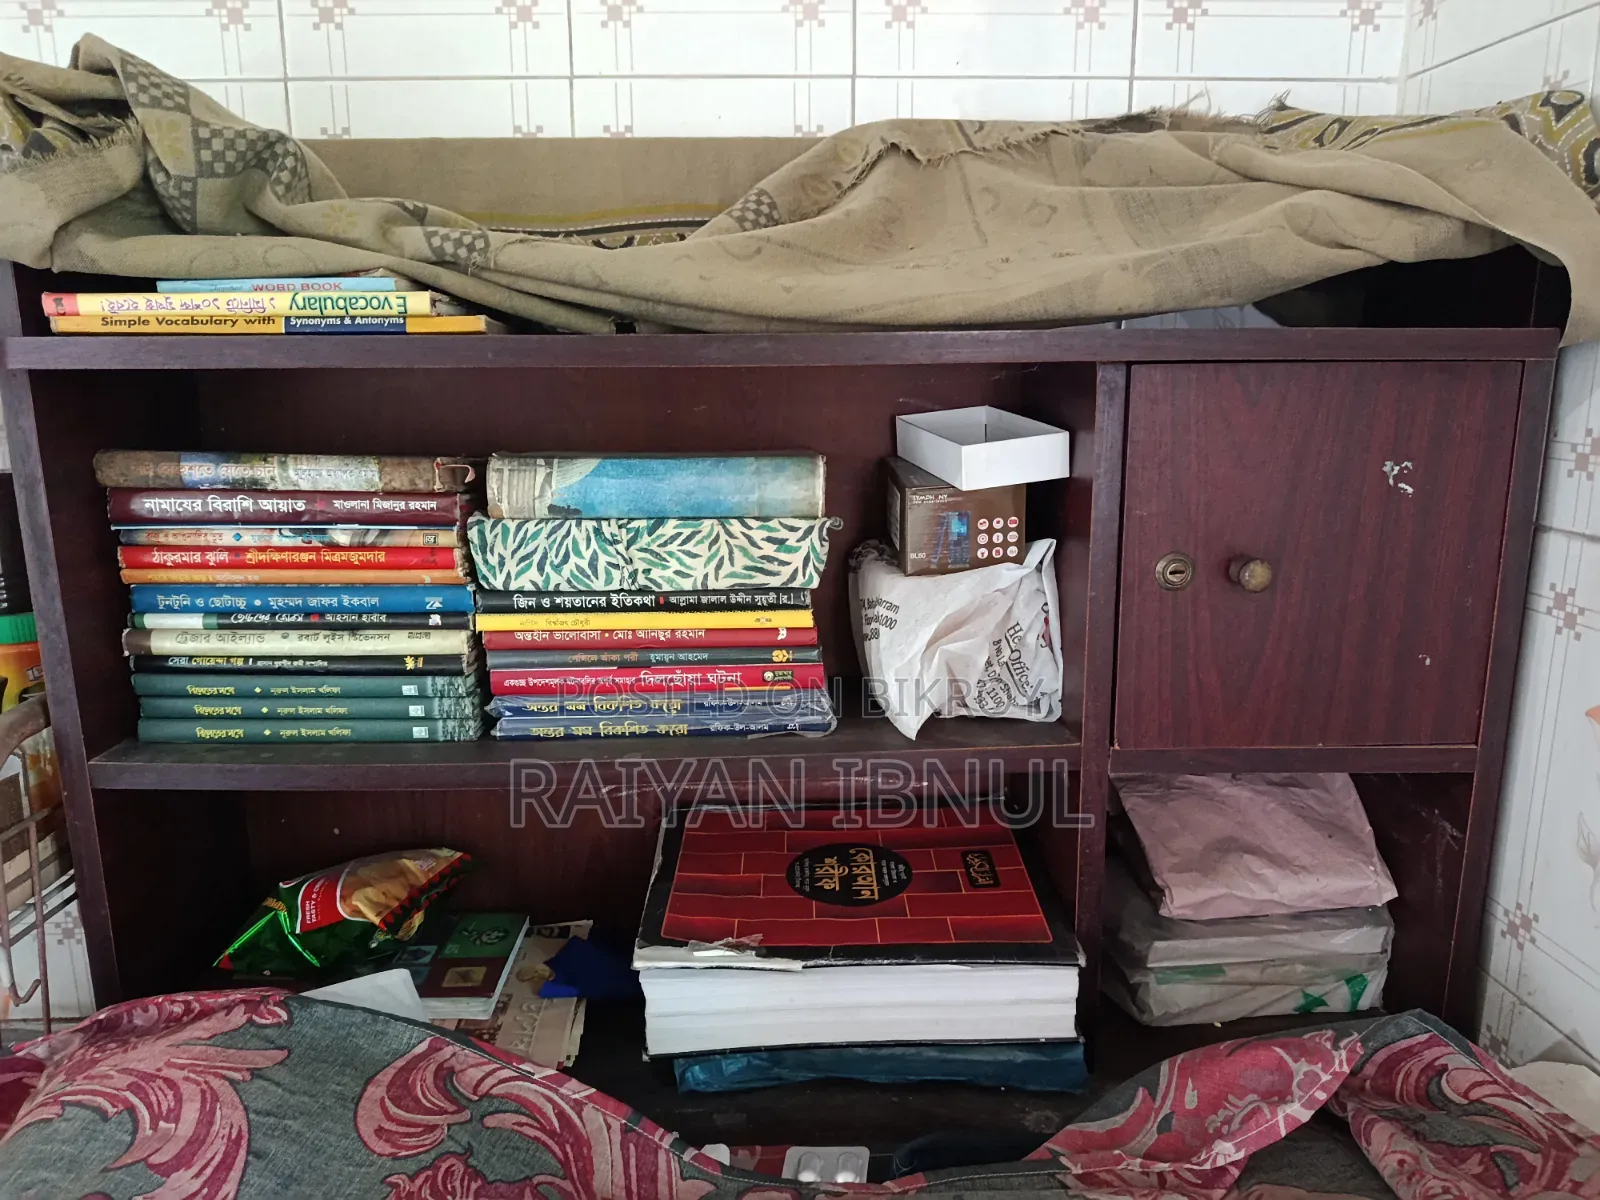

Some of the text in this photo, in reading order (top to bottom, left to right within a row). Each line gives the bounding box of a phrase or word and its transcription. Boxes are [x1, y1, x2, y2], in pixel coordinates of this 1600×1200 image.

[252, 283, 296, 292] WORD
[301, 282, 343, 291] BOOK
[101, 297, 140, 315] হবেই!
[145, 296, 176, 312] মুখস্থ
[226, 297, 267, 315] মিনিটে
[289, 292, 408, 316] E vocabulary
[101, 316, 404, 328] Simple Vocabulary with Synonyms & Antonyms
[143, 494, 437, 513] নামাযের বিরাশি আয়াত মাওলানা মিজানুর রহমান
[152, 547, 386, 567] ঠাকুরমার ঝুলি শ্রীদক্ষিণারঞ্জন মিত্রমজুমদার
[157, 594, 380, 610] টুনটুনি ও ছোটাচ্চু মুহম্মদ জাফর ইকবাল
[513, 594, 536, 609] জিন
[541, 597, 551, 607] ও
[554, 596, 606, 608] শয়তানের
[610, 593, 655, 608] ইতিকথা
[669, 595, 698, 606] আল্লামা
[700, 594, 727, 605] জালাল
[730, 592, 751, 605] উদ্দীন
[324, 612, 358, 623] আহসান
[175, 631, 211, 645] ট্রেজার
[216, 631, 266, 645] আইল্যান্ড
[297, 631, 321, 642] রবার্ট
[322, 632, 344, 645] লুইস
[553, 630, 601, 641] ভালোবাসা
[612, 630, 632, 640] মোঃ
[675, 629, 705, 640] রহমান
[1006, 621, 1025, 646] He
[168, 656, 188, 666] সেরা
[191, 656, 227, 666] গোয়েন্দা
[229, 656, 245, 667] গল্প
[678, 653, 709, 663] আহমেদ
[639, 670, 702, 687] দিলছোঁয়া
[708, 670, 742, 685] ঘটনা
[522, 702, 558, 713] অন্তর
[565, 701, 586, 711] মম
[594, 696, 642, 711] বিকশিত
[530, 727, 565, 737] অন্তর
[571, 726, 592, 736] মম
[600, 721, 648, 737] বিকশিত
[656, 723, 688, 737] করো
[814, 856, 849, 892] শরীফ
[849, 848, 879, 900] কোরআন
